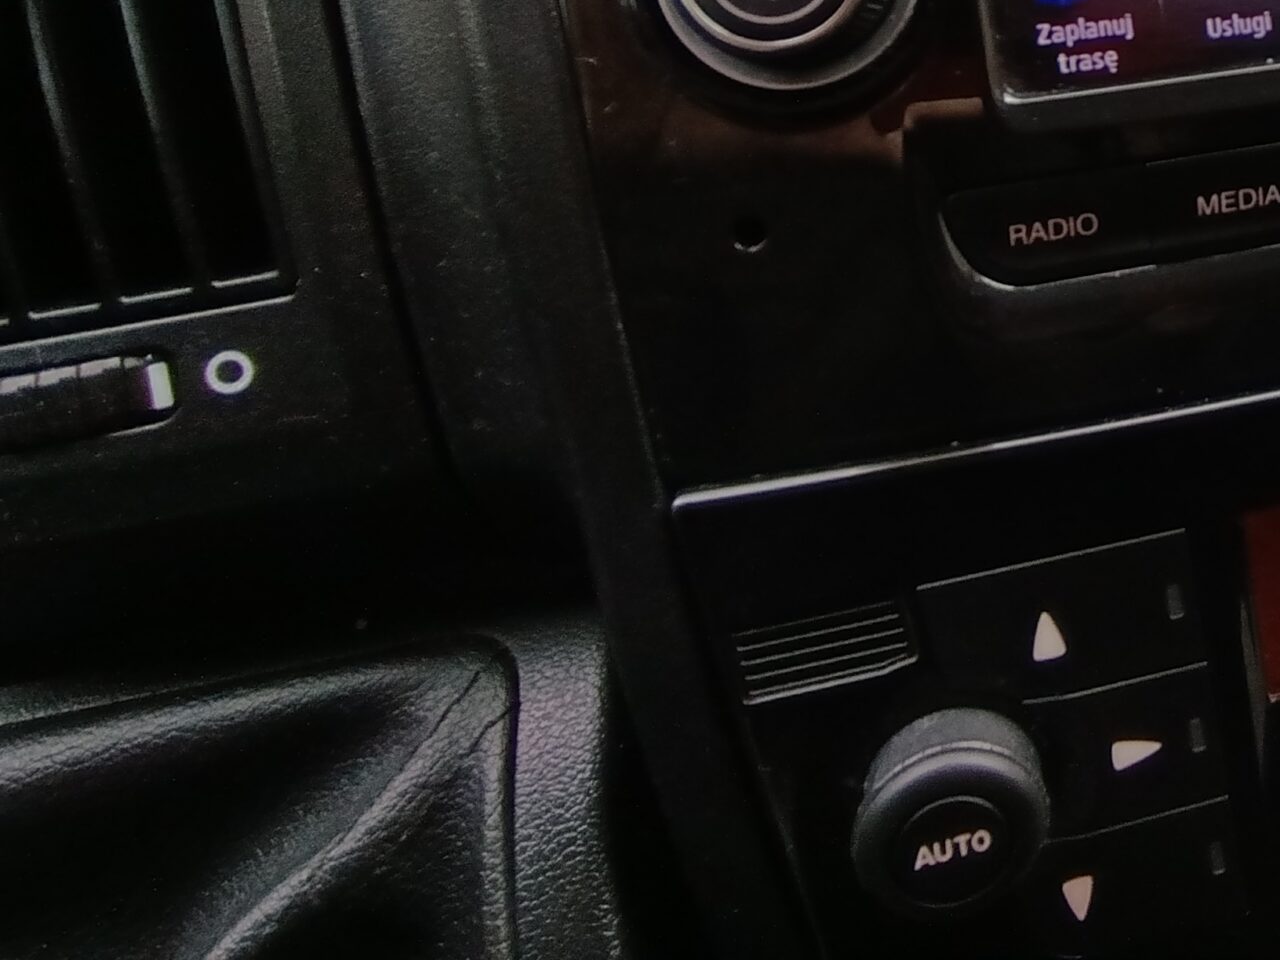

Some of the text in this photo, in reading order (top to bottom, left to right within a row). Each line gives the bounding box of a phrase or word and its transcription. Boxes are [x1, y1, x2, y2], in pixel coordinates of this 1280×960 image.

[1035, 12, 1135, 48] Zaplanuj
[1205, 11, 1273, 41] Usługi
[1057, 50, 1120, 75] trasę
[1008, 212, 1099, 247] RADIO
[914, 828, 993, 872] AUTO
